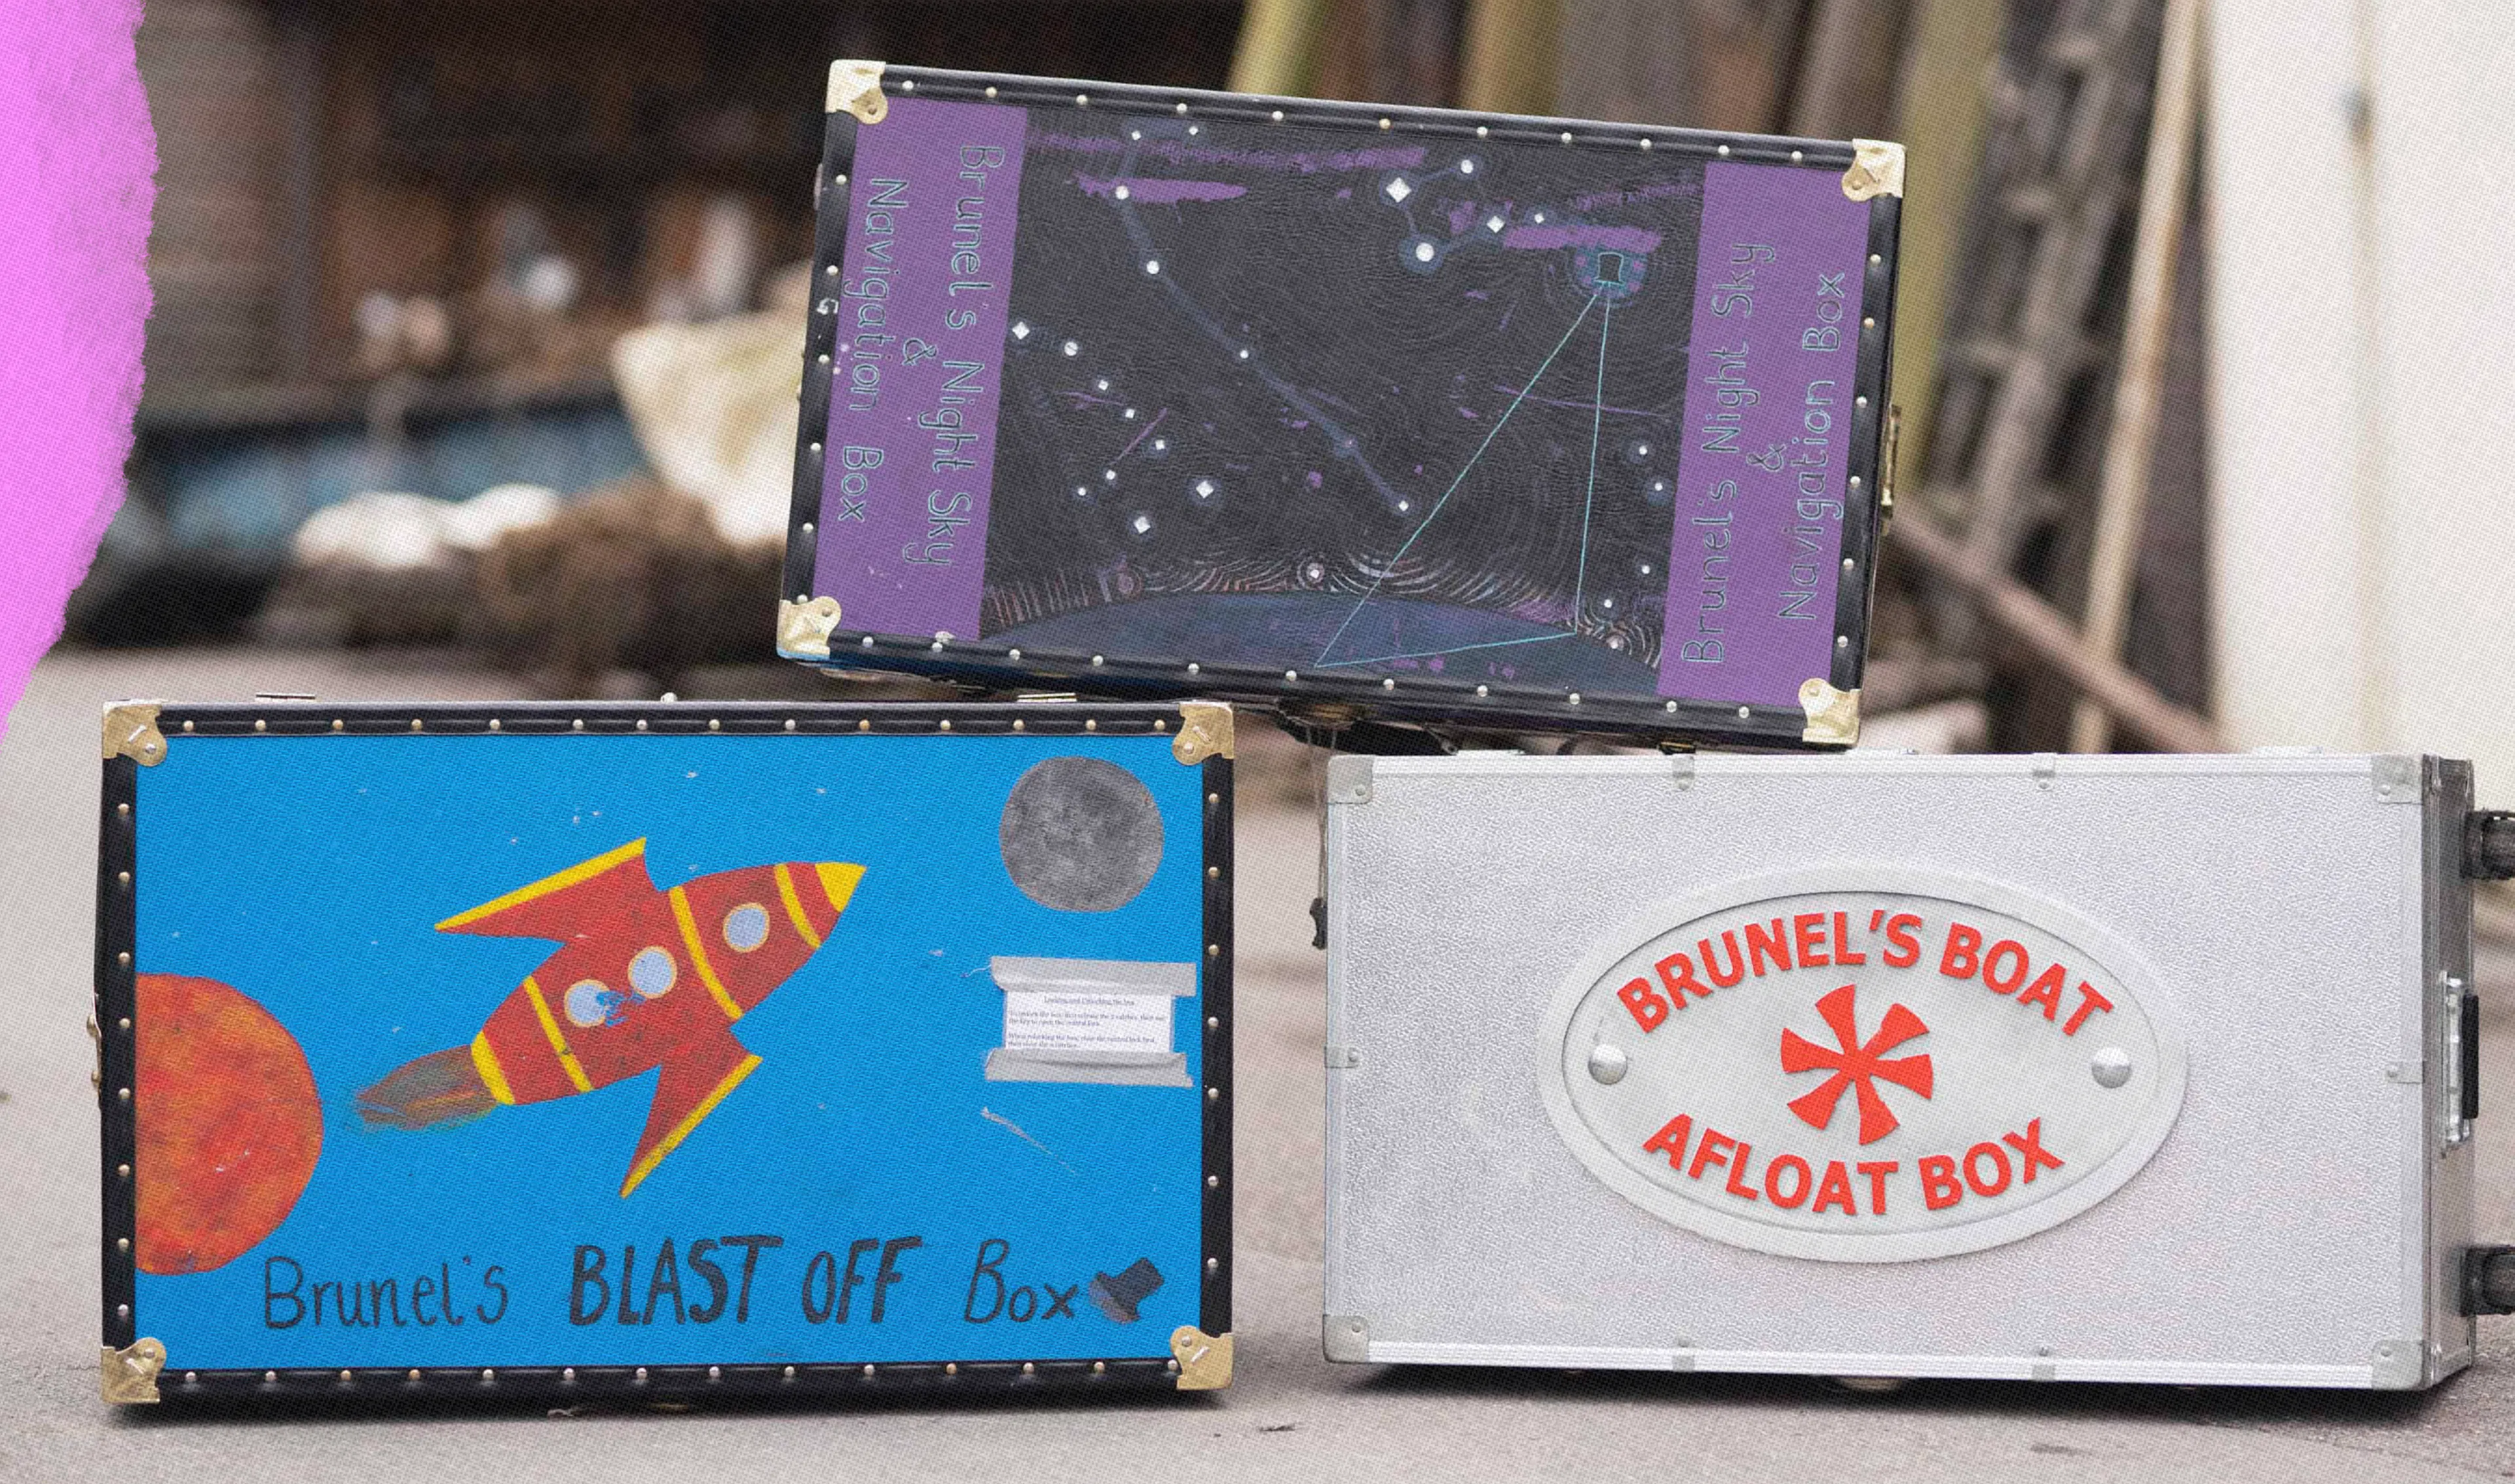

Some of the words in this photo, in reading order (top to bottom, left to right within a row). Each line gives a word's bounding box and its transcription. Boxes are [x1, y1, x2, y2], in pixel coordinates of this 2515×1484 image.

[944, 145, 1003, 329] Brunel's
[1712, 244, 1775, 317] Sky
[842, 178, 908, 411] Navigation
[1803, 274, 1844, 351] Box
[903, 339, 938, 365] &
[1702, 342, 1759, 453] Night
[920, 361, 985, 472] Night
[1747, 443, 1785, 470] &
[840, 446, 884, 521] Box
[904, 491, 972, 565] Sky
[1780, 380, 1844, 621] Navigation
[1682, 480, 1737, 663] Brunel's
[1616, 910, 1922, 1033] BRUNEL'S
[1939, 921, 2114, 1037] BOAT
[1642, 1113, 1898, 1215] AFLOAT
[1918, 1117, 2065, 1211] BOX
[263, 1255, 508, 1328] Brunel's
[569, 1234, 785, 1326] BLAST
[802, 1236, 923, 1325] OFF
[963, 1238, 1078, 1324] Box
